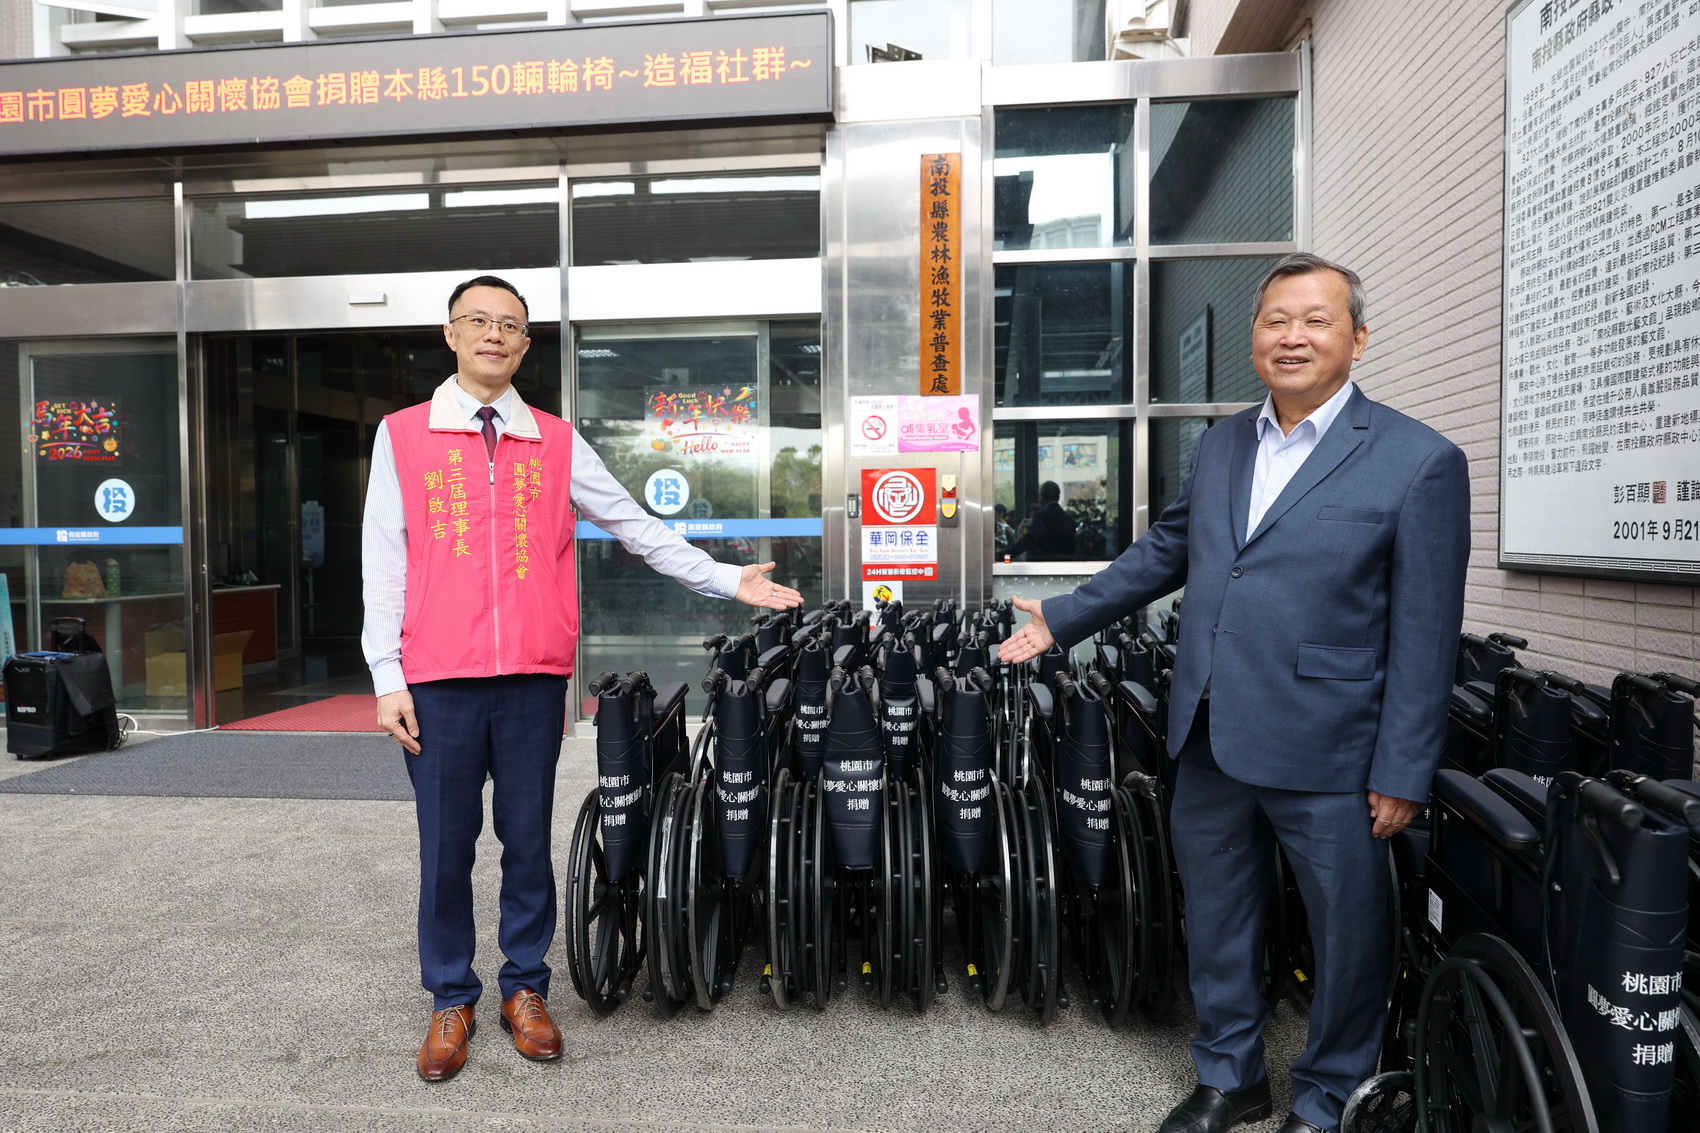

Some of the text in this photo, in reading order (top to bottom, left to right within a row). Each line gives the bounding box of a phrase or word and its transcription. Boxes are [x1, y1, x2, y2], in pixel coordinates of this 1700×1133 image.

[929, 154, 951, 394] 南投縣農林漁牧業普查處
[900, 423, 949, 434] 哺集乳室
[680, 436, 718, 455] Hello
[48, 445, 83, 461] 2026
[529, 455, 543, 502] 桃園市
[1614, 482, 1650, 504] 彭百顯
[447, 448, 471, 558] 第三屆理事長
[512, 462, 529, 580] 圓夢愛心關懷協會
[869, 531, 929, 546] 華岡保全
[800, 705, 824, 715] 桃園市
[888, 706, 913, 716] 桃園市
[840, 760, 873, 772] 桃園市
[723, 771, 753, 784] 桃園市
[954, 768, 985, 782] 桃園市
[824, 779, 882, 793] 夢愛心關懷
[1080, 778, 1110, 791] 桃園市
[847, 798, 869, 810] 捐贈
[604, 813, 626, 826] 捐贈
[726, 809, 748, 821] 捐贈
[960, 807, 981, 819] 捐贈
[1087, 817, 1109, 830] 捐贈
[1621, 971, 1683, 996] 桃園市
[1632, 1042, 1674, 1066] 捐贈
